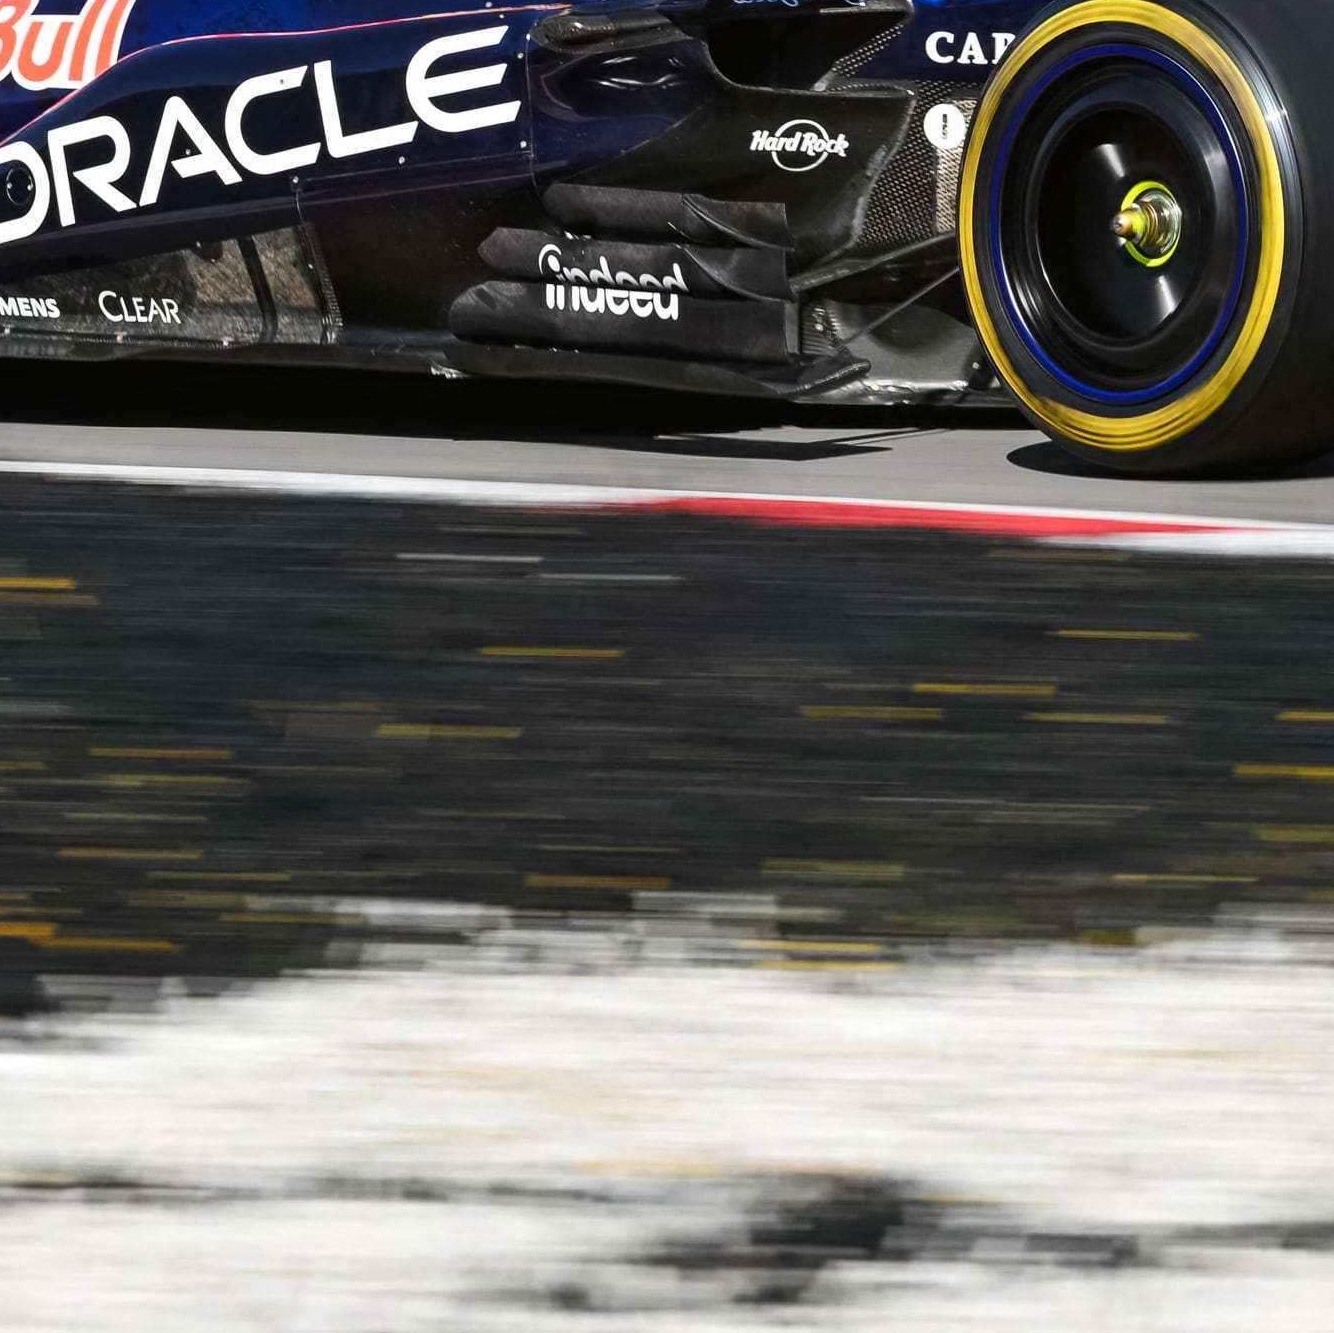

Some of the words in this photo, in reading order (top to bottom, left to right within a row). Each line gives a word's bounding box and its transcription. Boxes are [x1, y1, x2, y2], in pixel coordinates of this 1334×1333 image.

[750, 130, 803, 152] Hard
[799, 132, 849, 157] Rock
[538, 243, 690, 321] indeed
[98, 290, 182, 325] CLEAR
